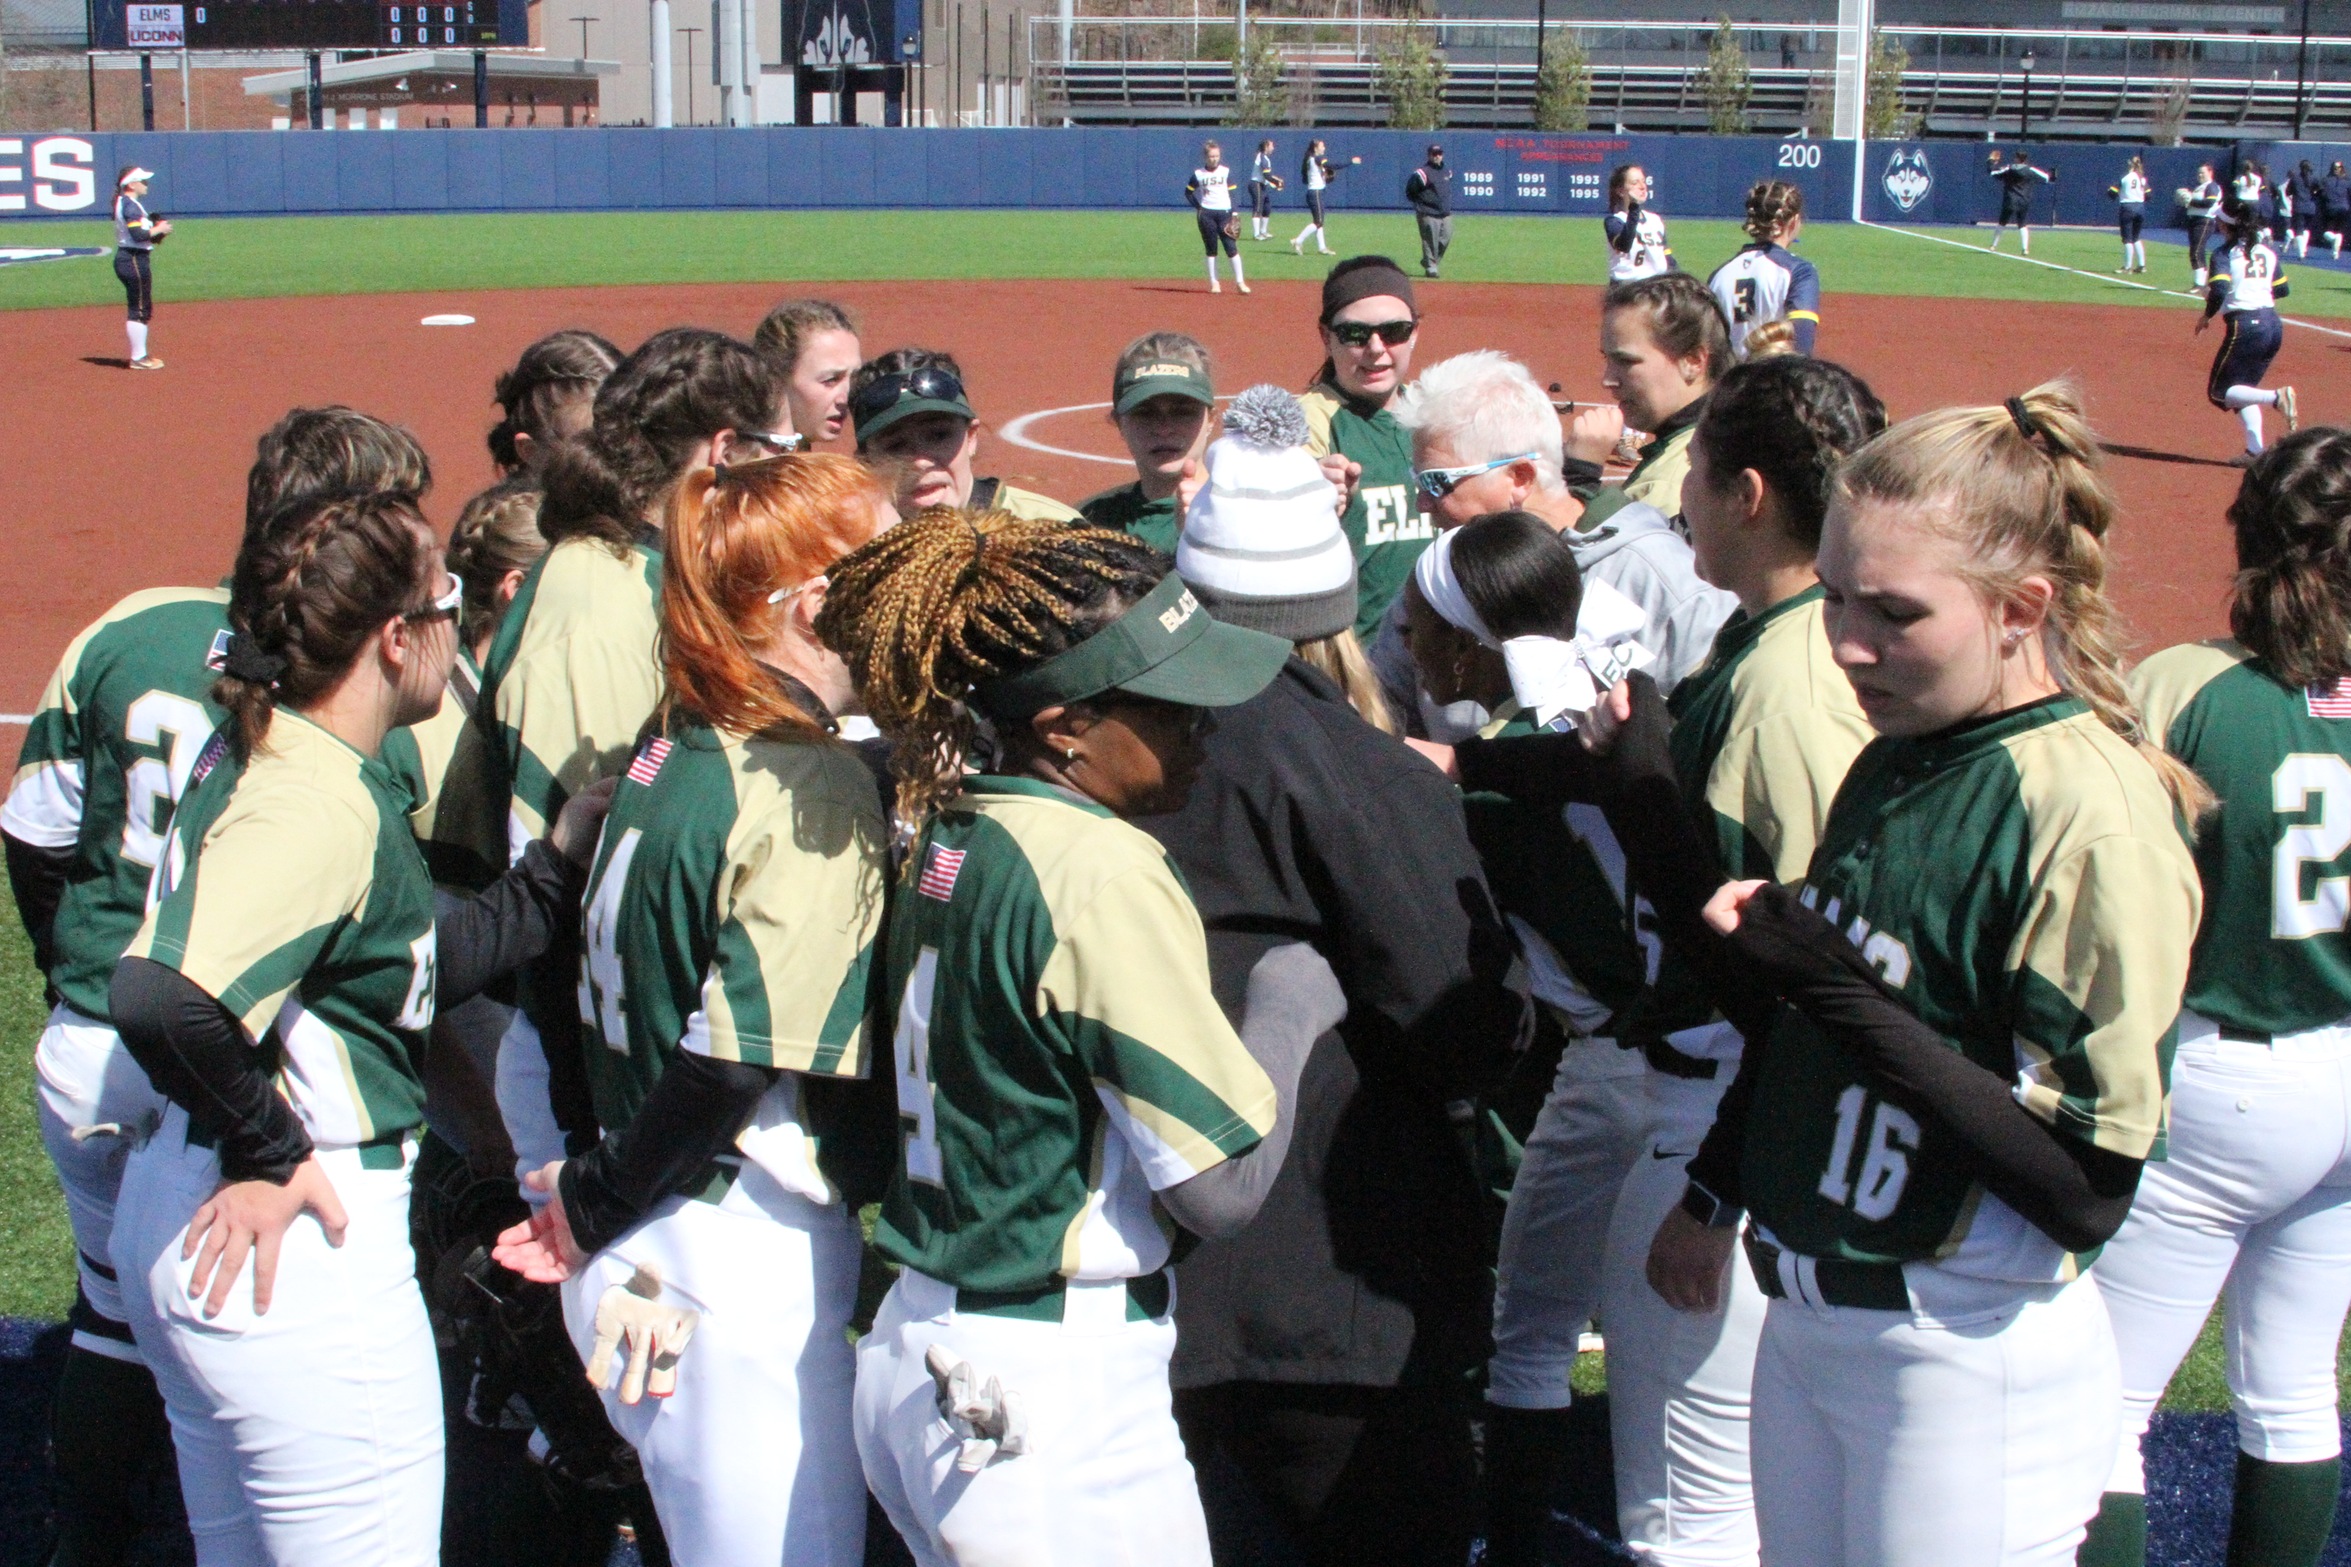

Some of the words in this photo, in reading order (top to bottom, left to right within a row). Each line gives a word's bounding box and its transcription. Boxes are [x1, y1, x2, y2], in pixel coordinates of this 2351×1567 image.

[140, 8, 171, 21] ELMS
[195, 7, 206, 23] 0
[391, 7, 400, 22] 0
[417, 7, 427, 22] 0
[444, 7, 454, 22] 0
[130, 30, 183, 42] UCONN
[391, 28, 400, 43] 0
[418, 28, 427, 43] 0
[445, 28, 455, 43] 0
[1778, 144, 1821, 168] 200
[1202, 177, 1224, 186] USJ
[1463, 172, 1493, 183] 1989
[1517, 173, 1545, 183] 1991
[1570, 174, 1600, 185] 1993
[1463, 186, 1494, 196] 1990
[1517, 187, 1547, 197] 1992
[1570, 188, 1600, 198] 1995
[1634, 250, 1646, 267] 6
[1734, 278, 1756, 322] 3
[1134, 363, 1190, 379] BLAZERS
[1818, 1083, 1922, 1222] 16
